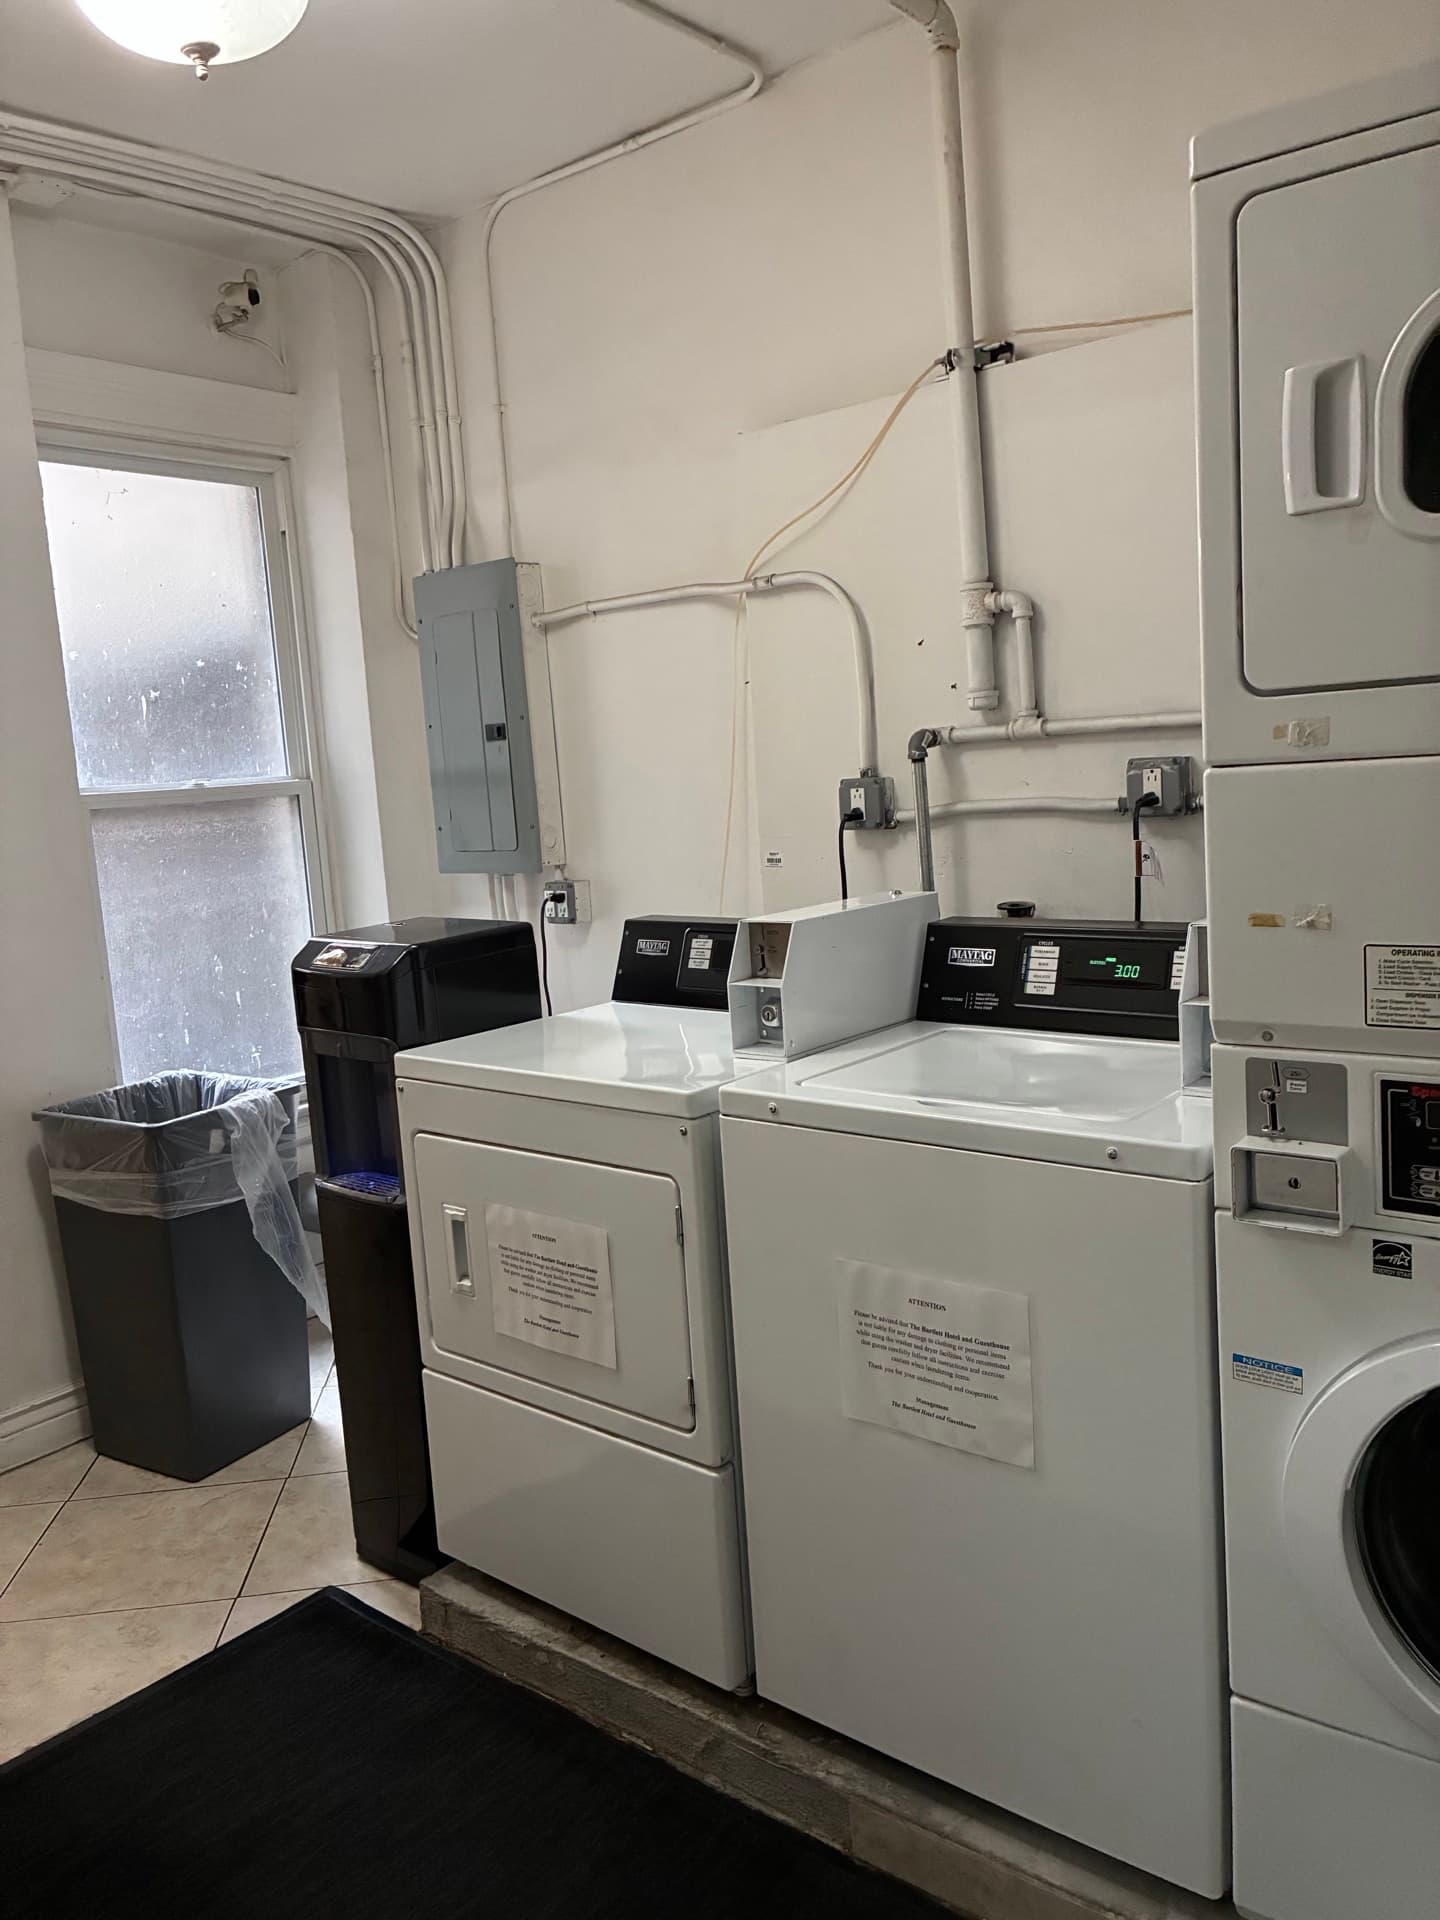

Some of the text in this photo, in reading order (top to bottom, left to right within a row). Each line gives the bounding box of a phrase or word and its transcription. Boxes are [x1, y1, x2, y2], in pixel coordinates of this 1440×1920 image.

[639, 942, 667, 950] MAYTAG
[951, 950, 992, 960] MAYTAG
[1391, 949, 1435, 957] OPERATING
[1114, 965, 1140, 978] 3.00
[907, 1297, 946, 1311] ATTENTION
[1242, 1357, 1294, 1374] NOTICE
